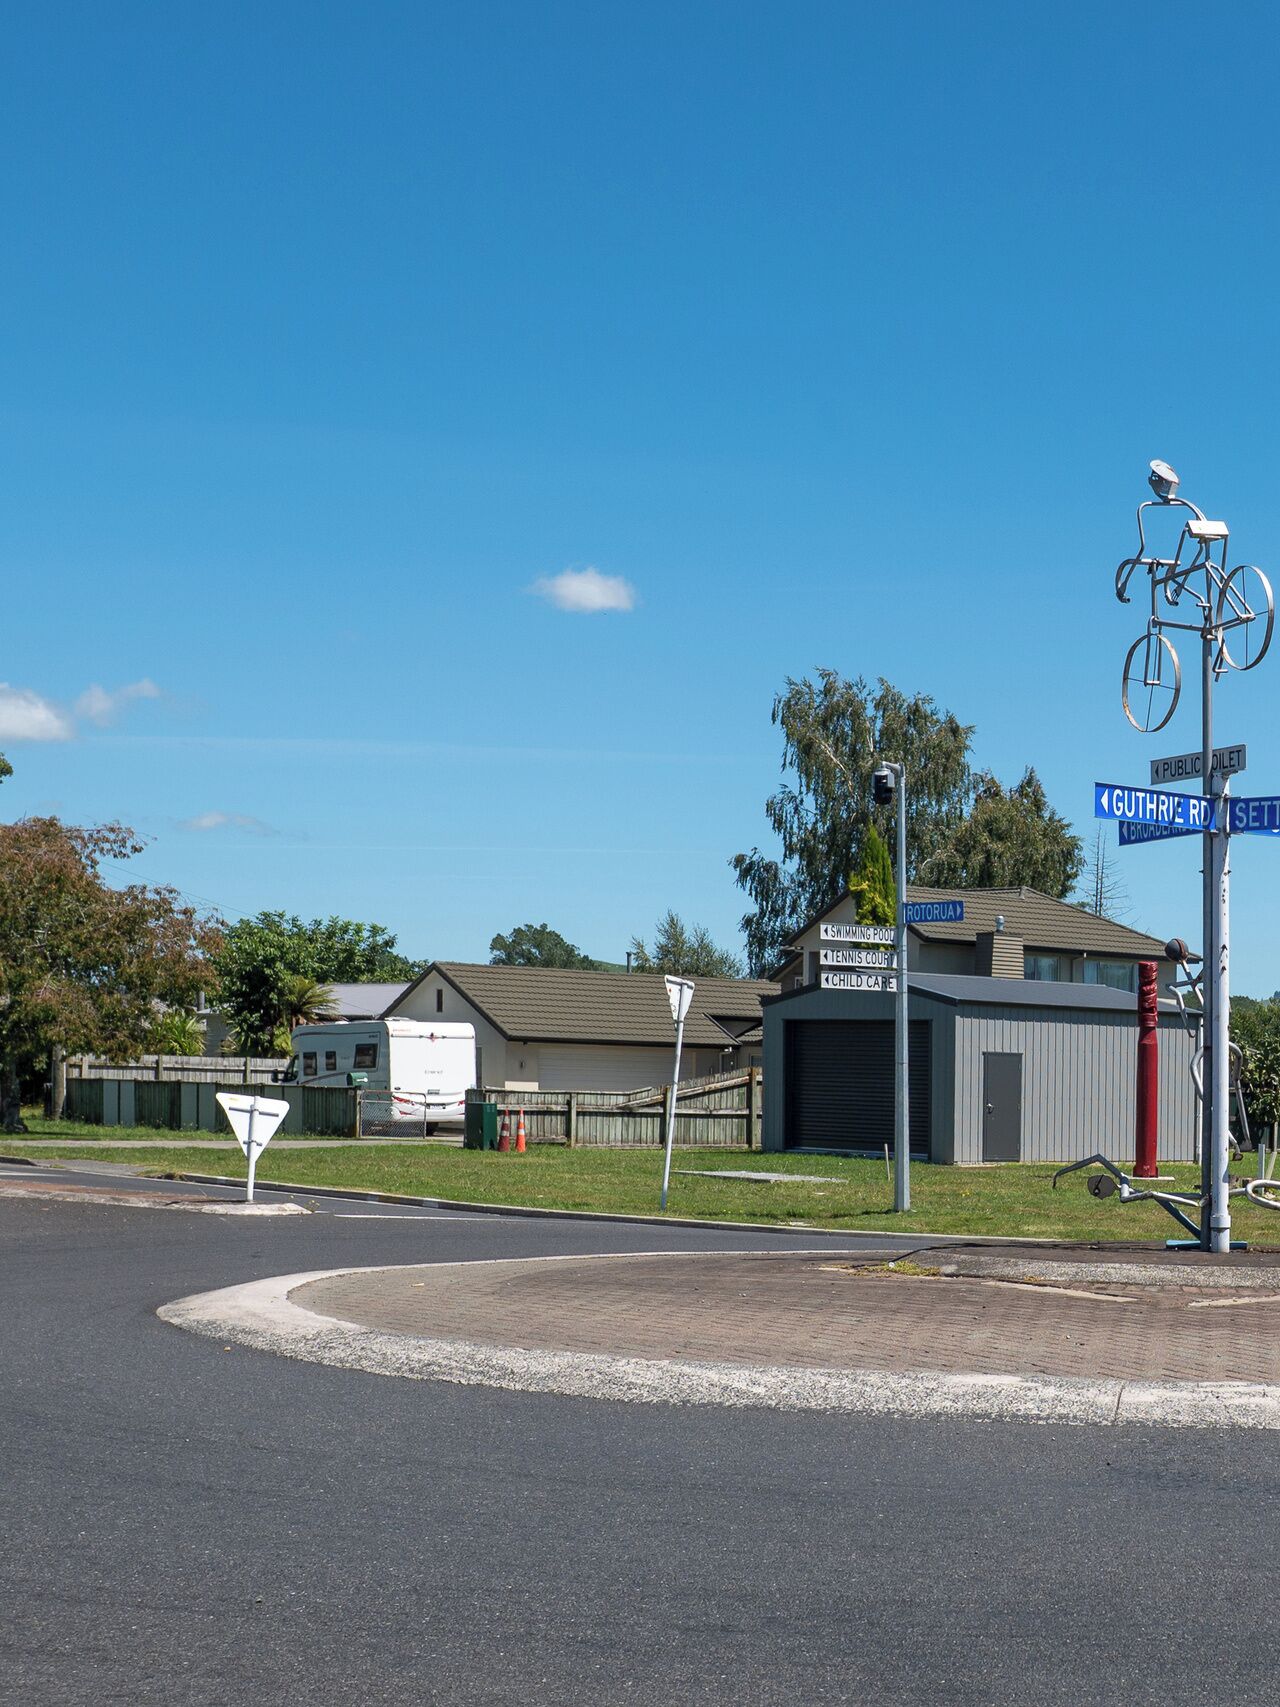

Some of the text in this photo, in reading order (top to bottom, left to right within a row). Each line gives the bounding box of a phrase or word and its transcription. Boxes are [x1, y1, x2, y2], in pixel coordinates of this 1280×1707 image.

[1163, 749, 1242, 779] PUBLIC OILET
[1113, 789, 1211, 826] GUTHRIE RD
[907, 903, 954, 921] ROTORUA
[830, 925, 894, 942] SWIMMING POOL
[830, 950, 894, 966] TENNIS COURT
[831, 974, 894, 989] CHILD CARE
